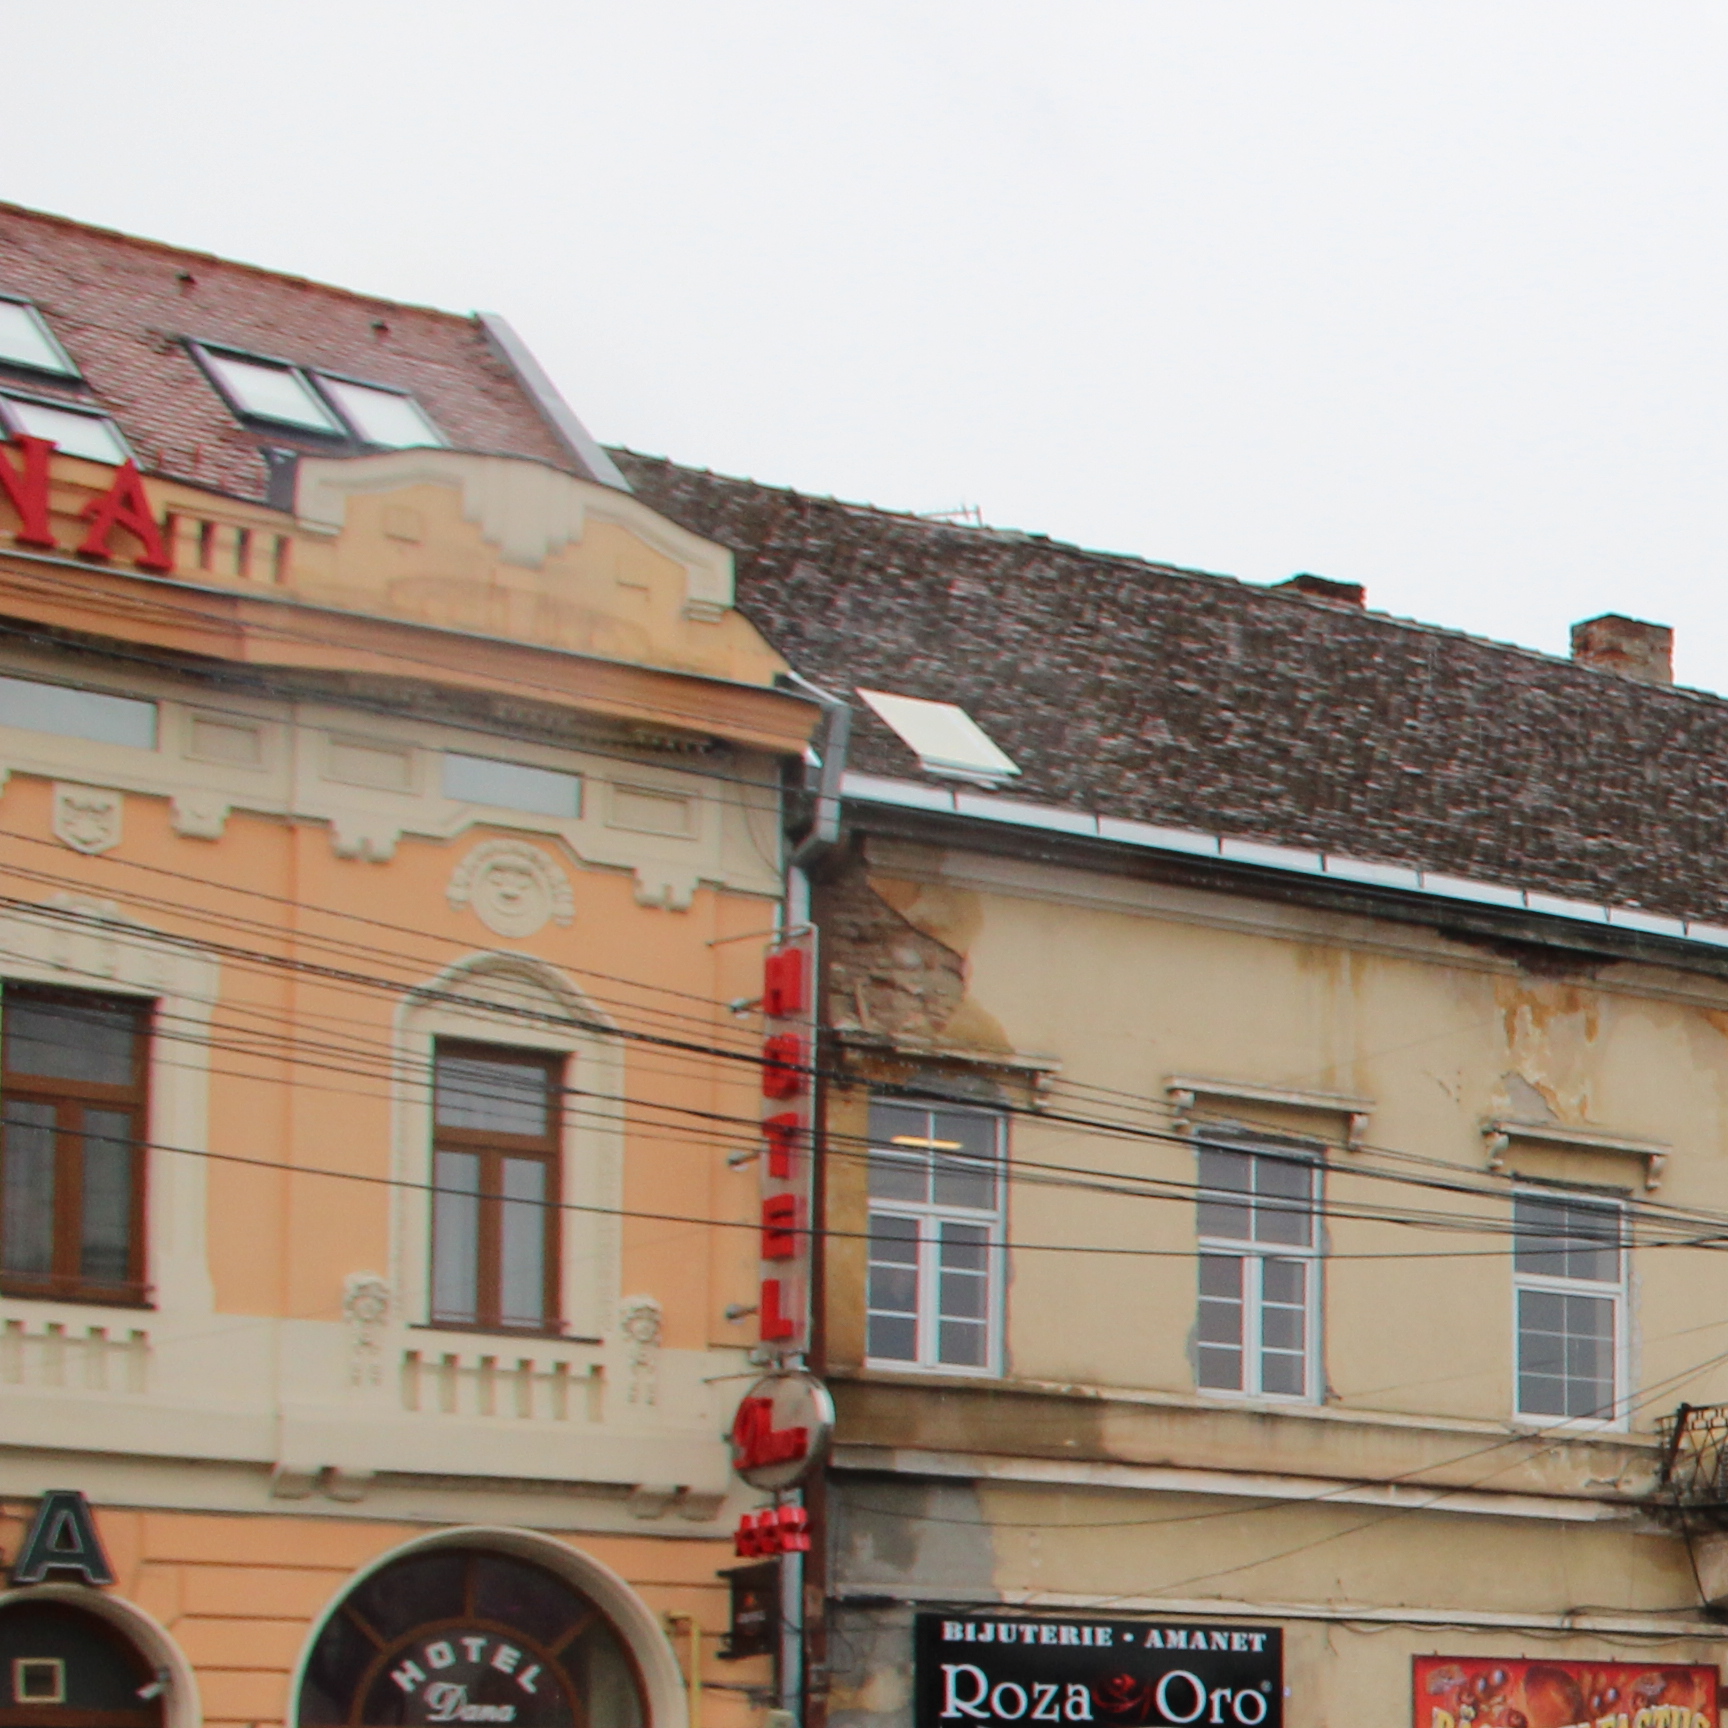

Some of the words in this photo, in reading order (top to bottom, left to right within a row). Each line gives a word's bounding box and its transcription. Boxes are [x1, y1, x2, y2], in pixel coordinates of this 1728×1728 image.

[941, 1620, 1113, 1648] BIJUTERIE
[1143, 1627, 1268, 1652] AMANET
[389, 1636, 543, 1695] HOTEL
[423, 1681, 517, 1723] Dana
[940, 1663, 1095, 1723] Roza
[1155, 1669, 1268, 1726] Oro
